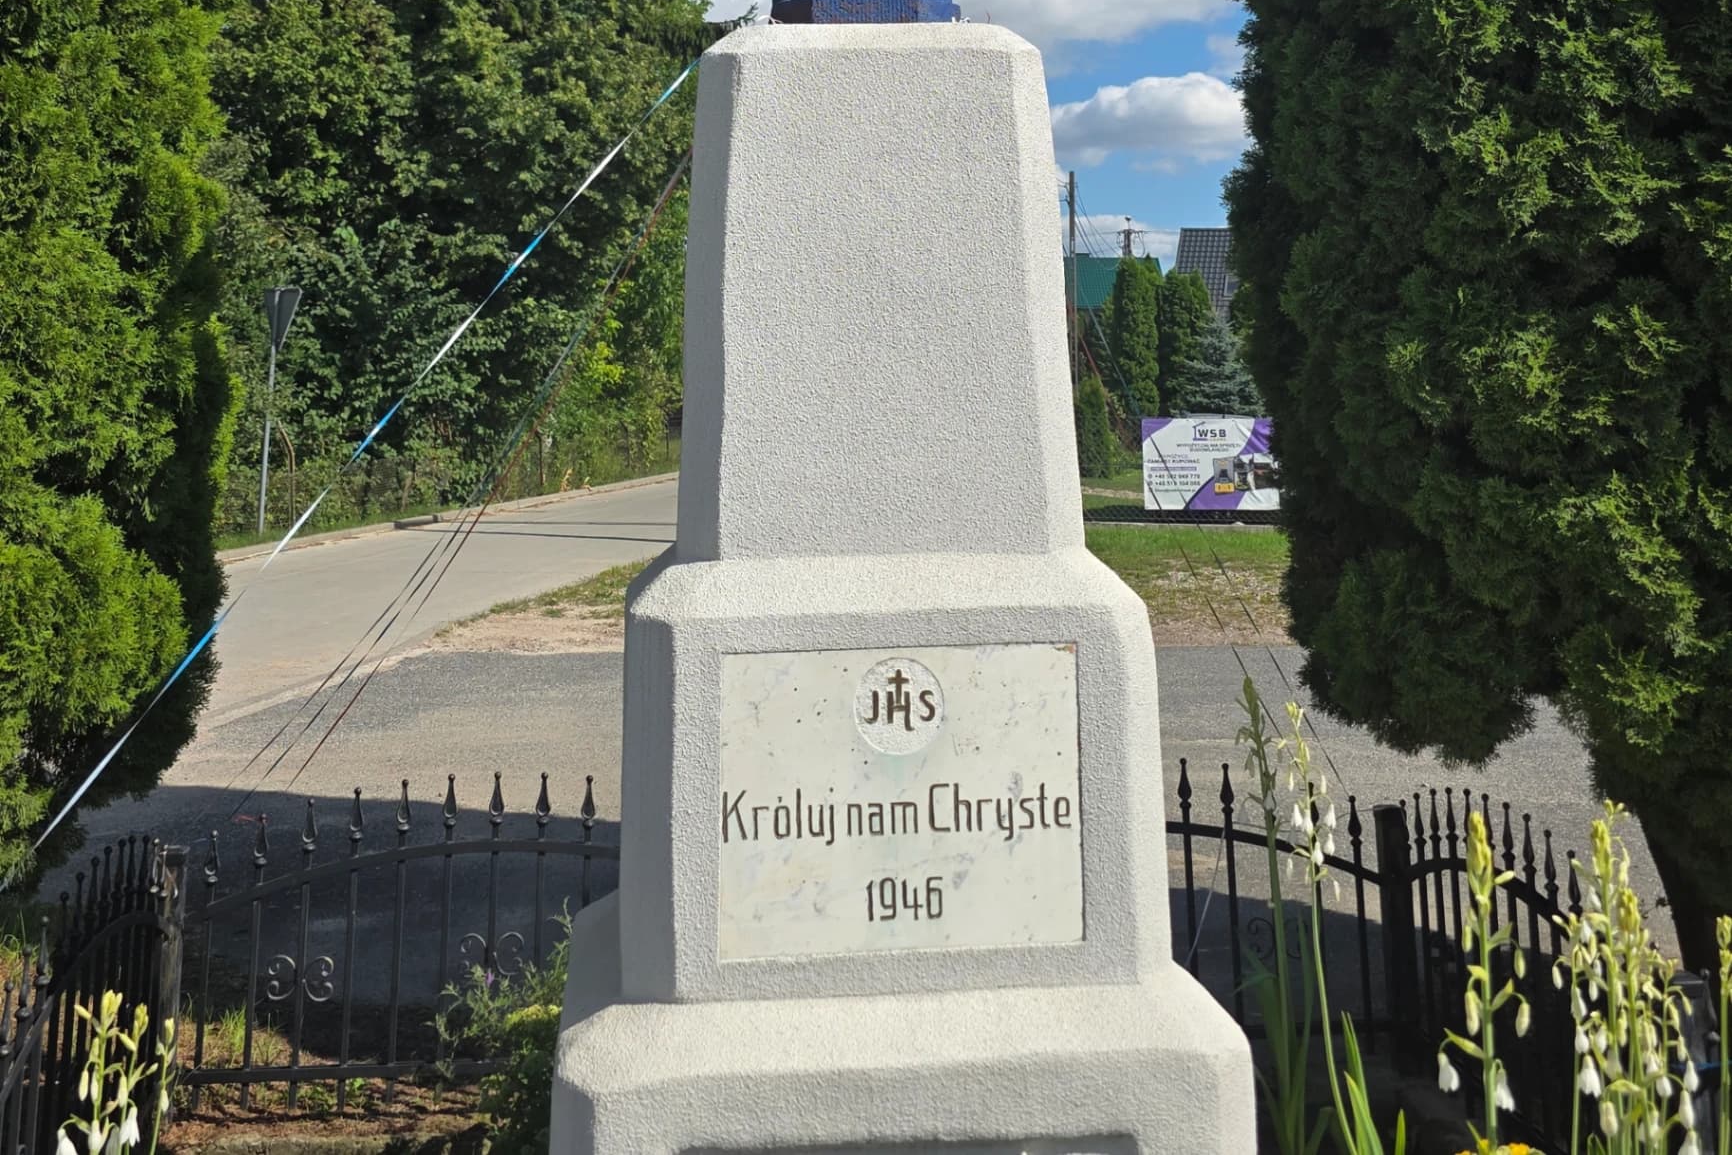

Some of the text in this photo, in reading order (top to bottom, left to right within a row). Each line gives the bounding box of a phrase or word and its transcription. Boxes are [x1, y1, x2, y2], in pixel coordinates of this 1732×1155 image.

[1197, 429, 1227, 438] WSB
[721, 781, 1073, 846] Króluj nam Chryste
[865, 876, 944, 922] 1946
